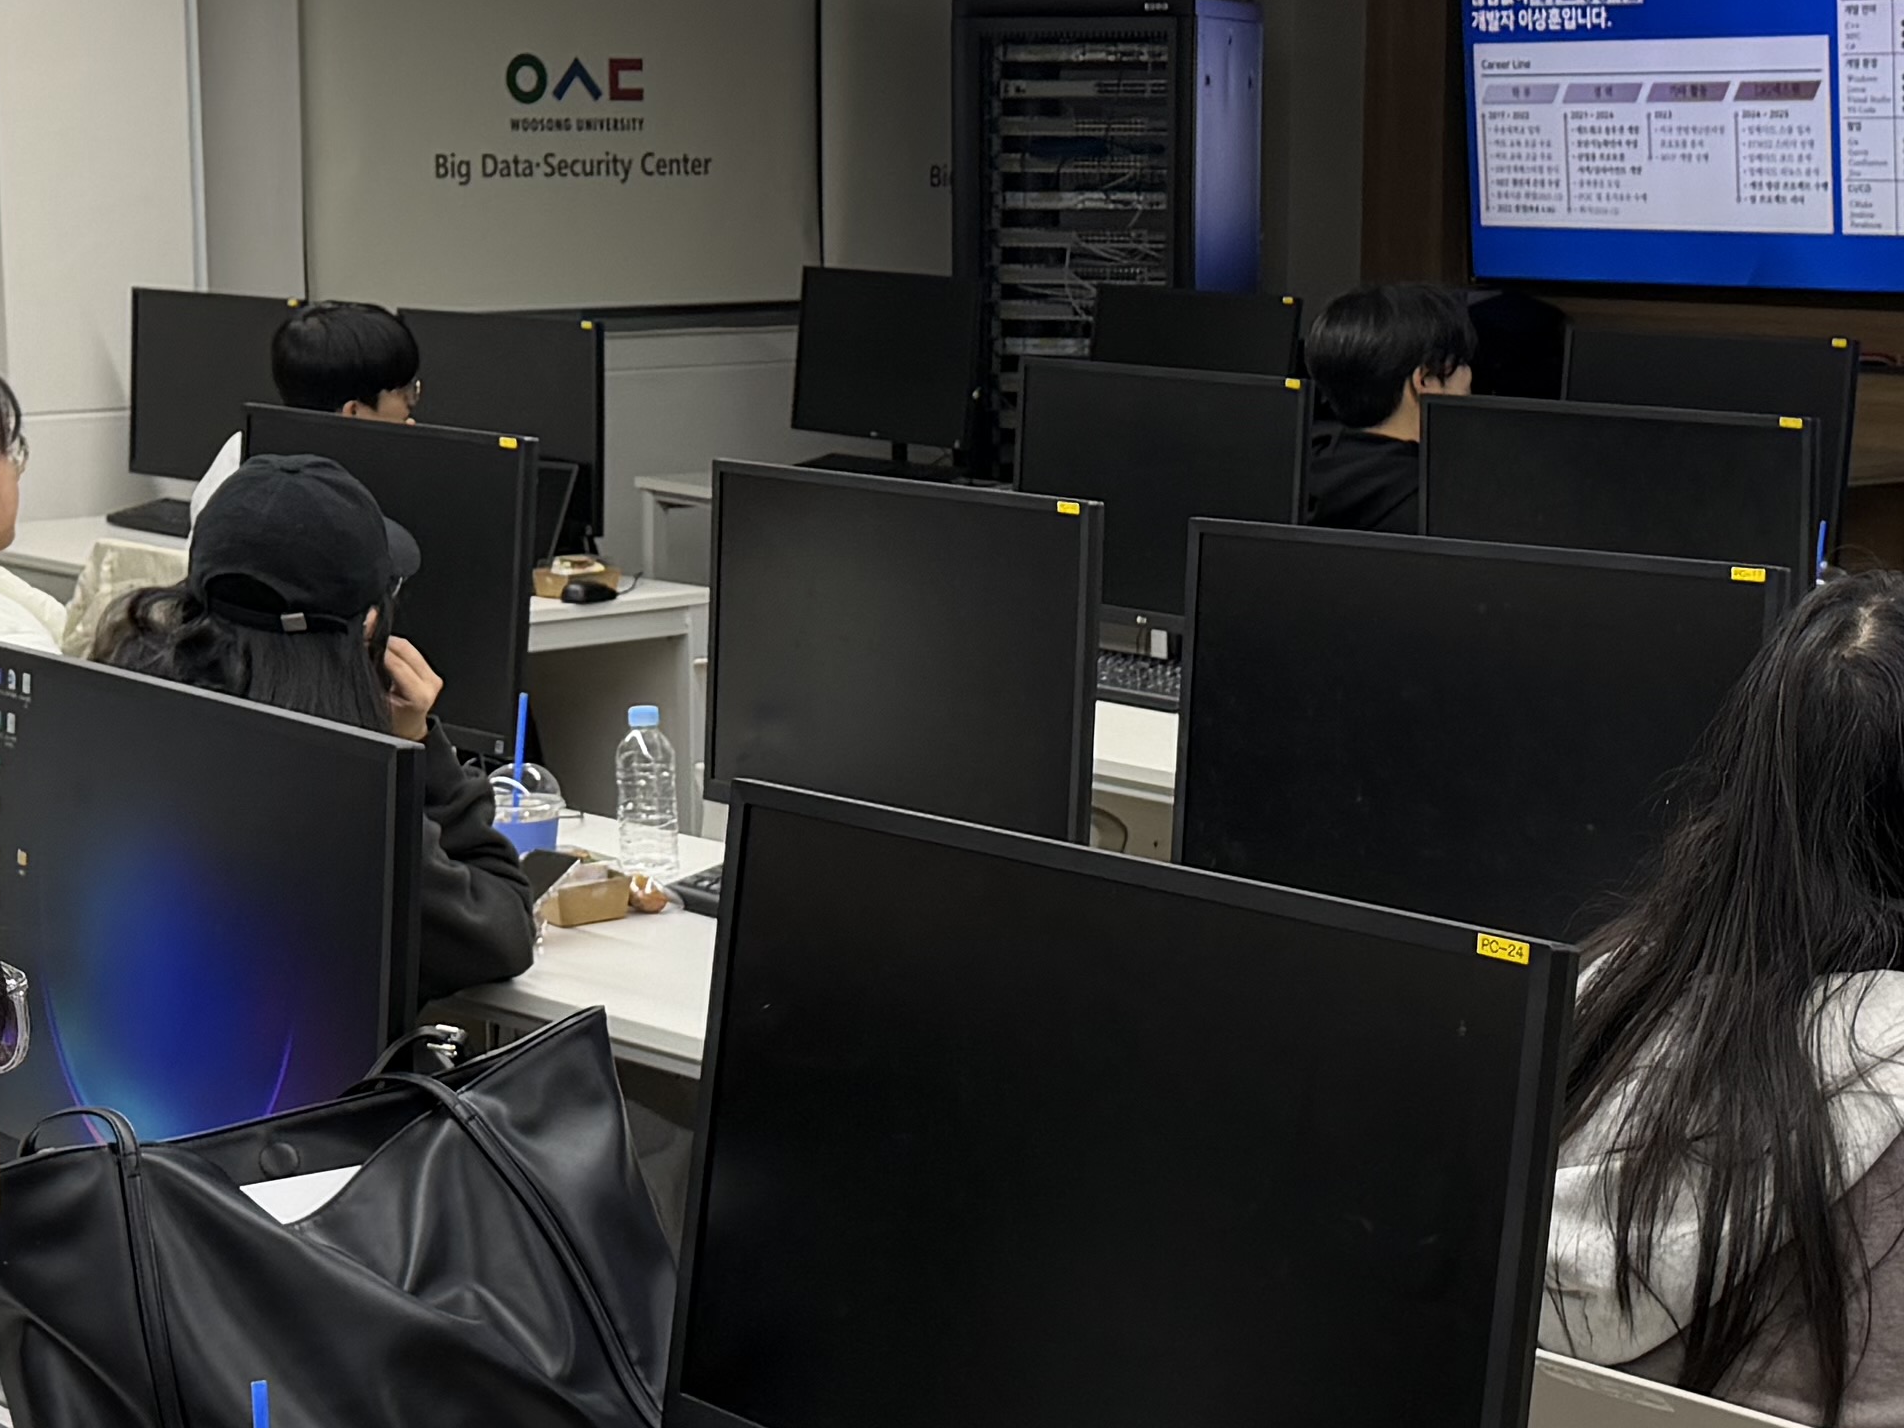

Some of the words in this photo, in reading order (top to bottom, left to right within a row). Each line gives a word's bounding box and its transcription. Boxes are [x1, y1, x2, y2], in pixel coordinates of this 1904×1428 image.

[511, 118, 572, 132] WOOSONG
[576, 118, 644, 132] UNIVERSITY
[435, 153, 471, 186] Big
[641, 152, 712, 177] Center
[1482, 938, 1524, 959] PC-24
